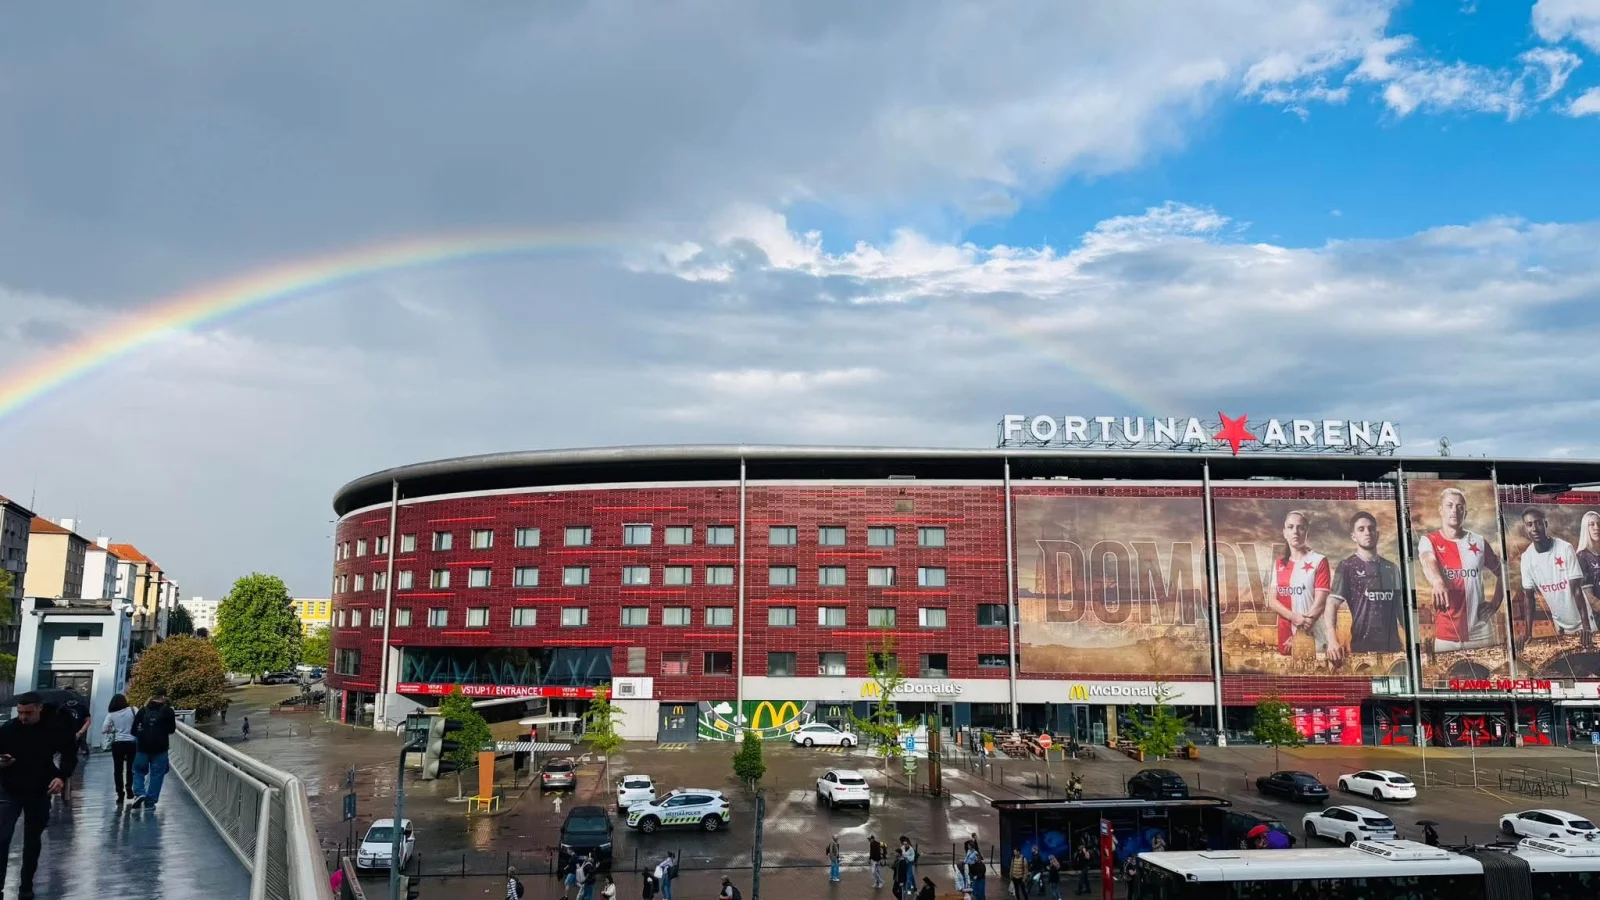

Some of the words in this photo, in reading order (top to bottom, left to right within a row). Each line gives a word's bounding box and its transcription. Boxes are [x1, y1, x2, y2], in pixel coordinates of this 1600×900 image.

[1002, 414, 1208, 444] FORTUNA
[1263, 418, 1400, 447] ARENA
[1036, 539, 1287, 627] DOMOV
[461, 685, 485, 695] VSTUP
[496, 686, 537, 696] ENTRANCE
[885, 682, 964, 694] cDonald's
[1450, 679, 1492, 690] SLAVIA
[1496, 679, 1551, 690] MUSEUM
[1089, 685, 1171, 697] McDonald's
